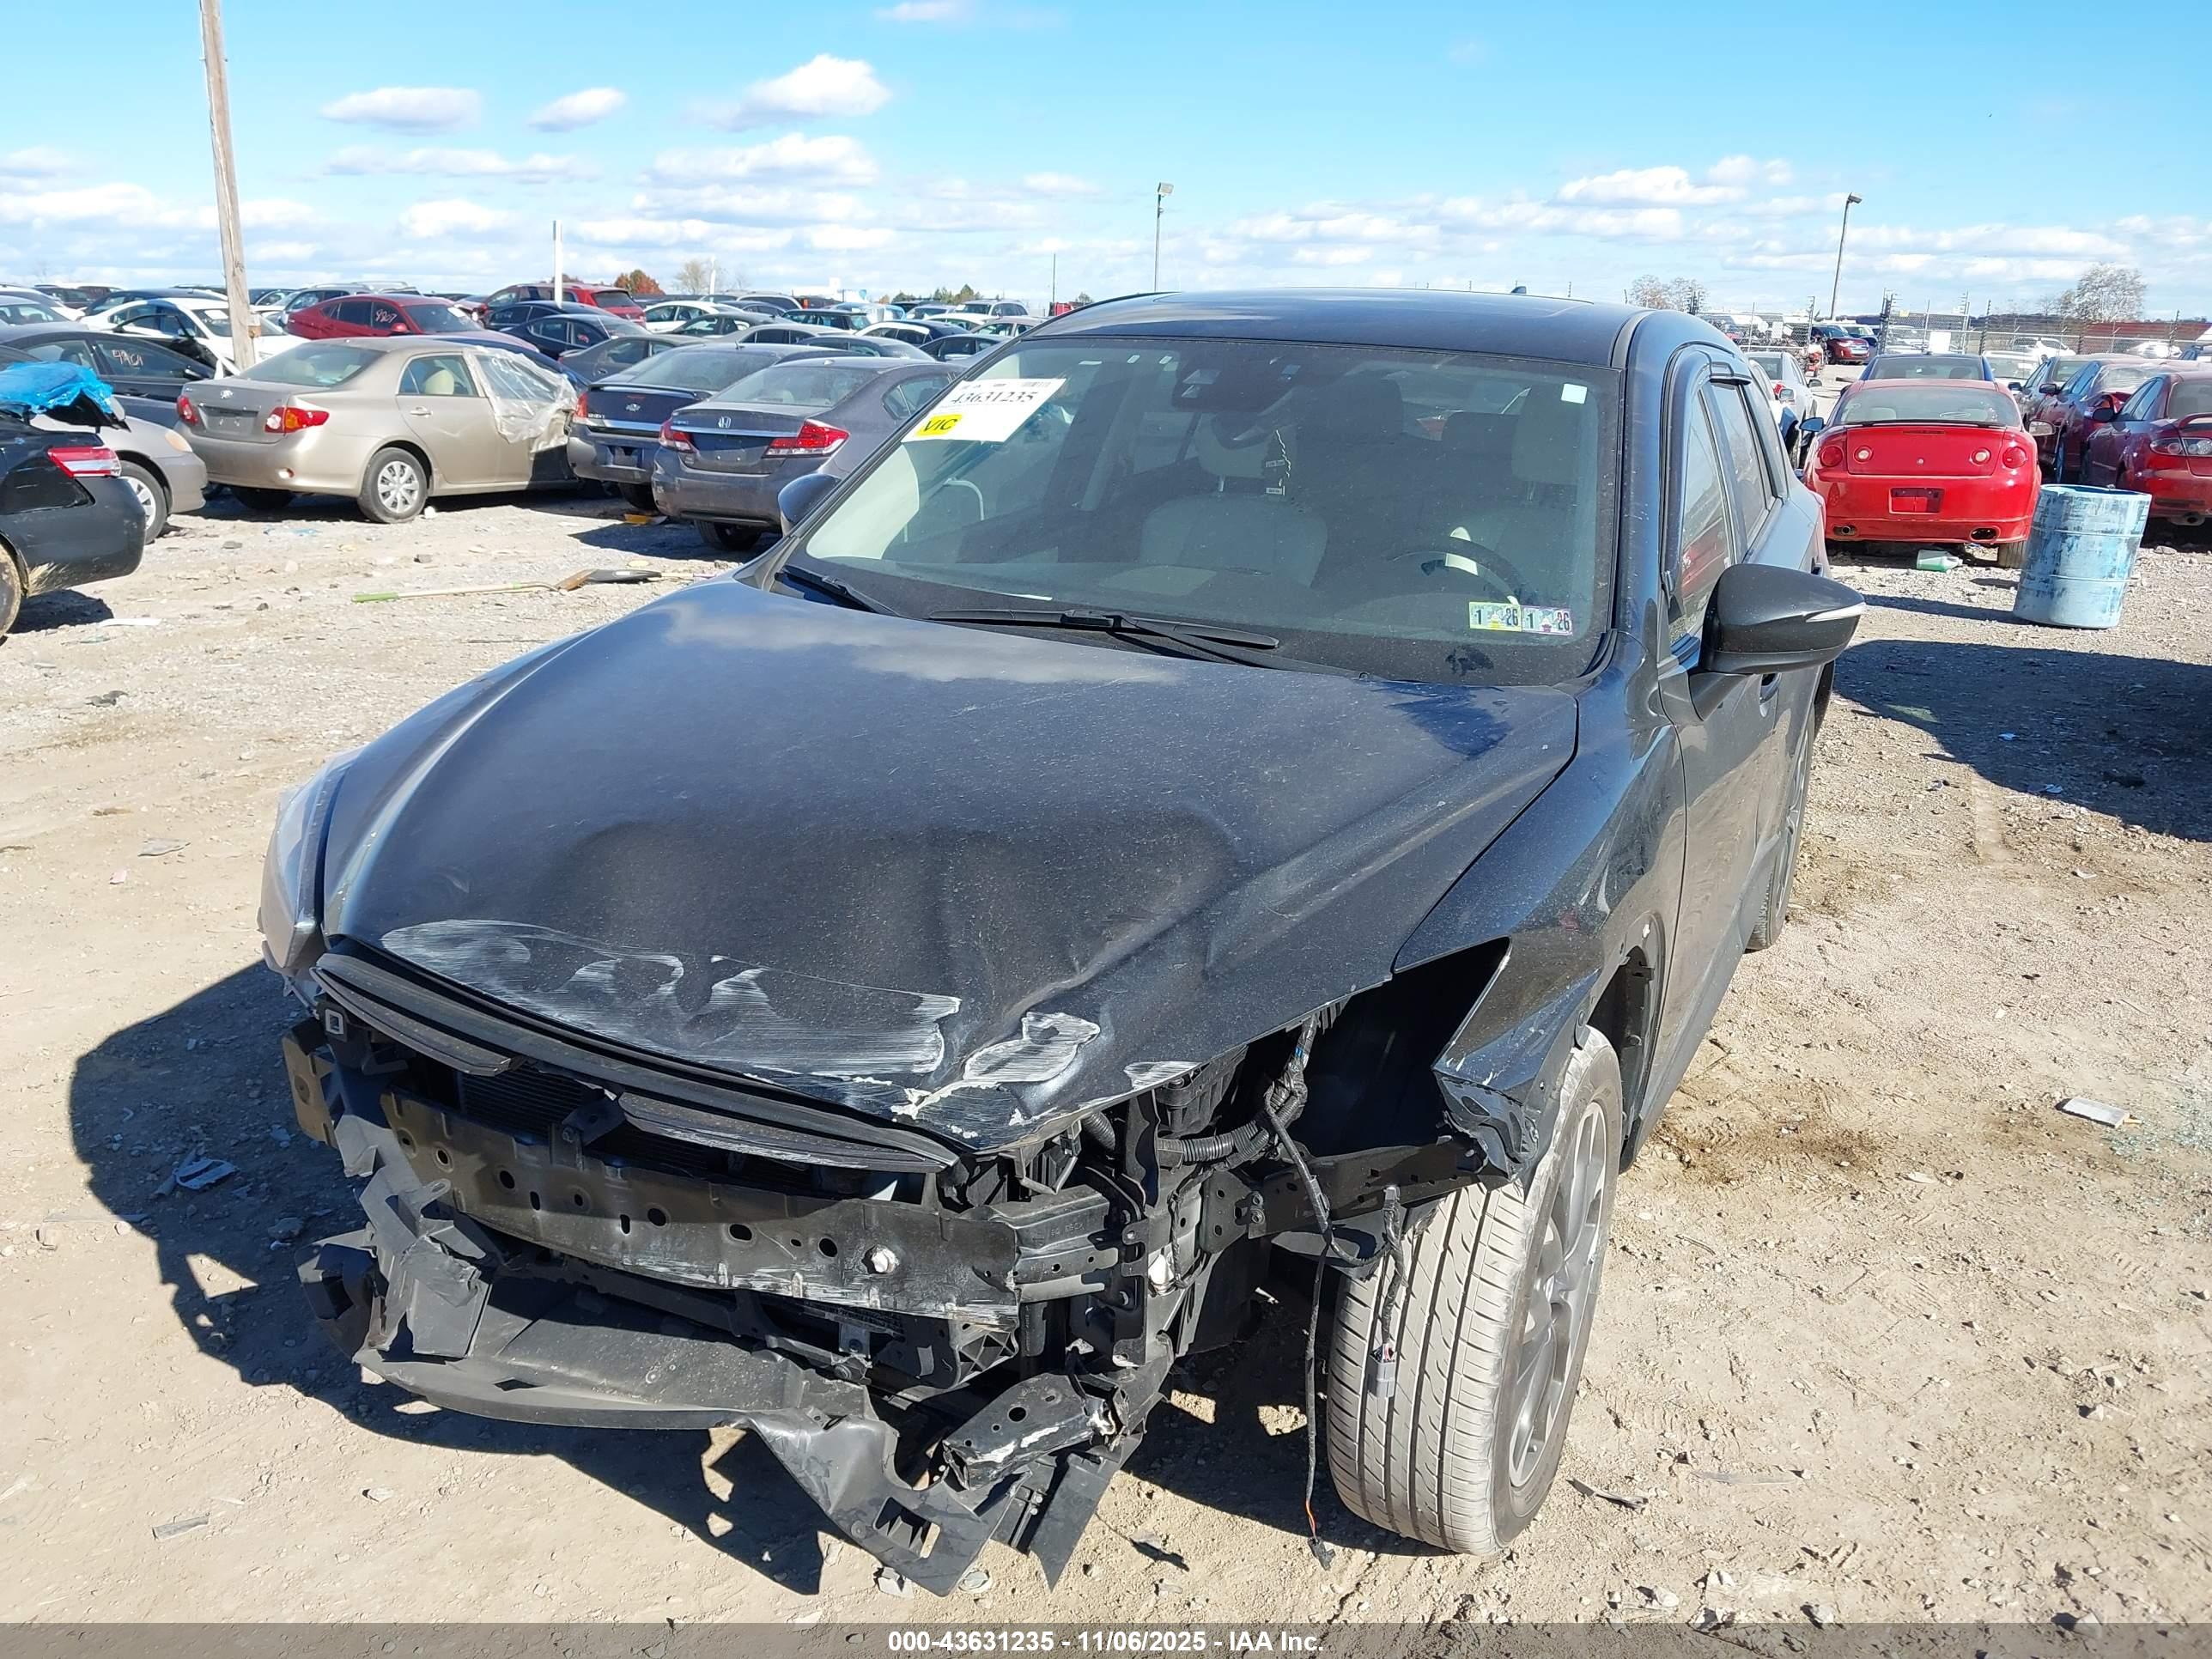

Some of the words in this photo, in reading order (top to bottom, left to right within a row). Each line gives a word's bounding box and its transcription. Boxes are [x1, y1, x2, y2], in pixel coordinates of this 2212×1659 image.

[923, 418, 958, 432] VIC
[1475, 609, 1483, 625] 1
[1506, 607, 1519, 627] 26
[1527, 612, 1534, 629] 1
[1557, 611, 1570, 631] 26
